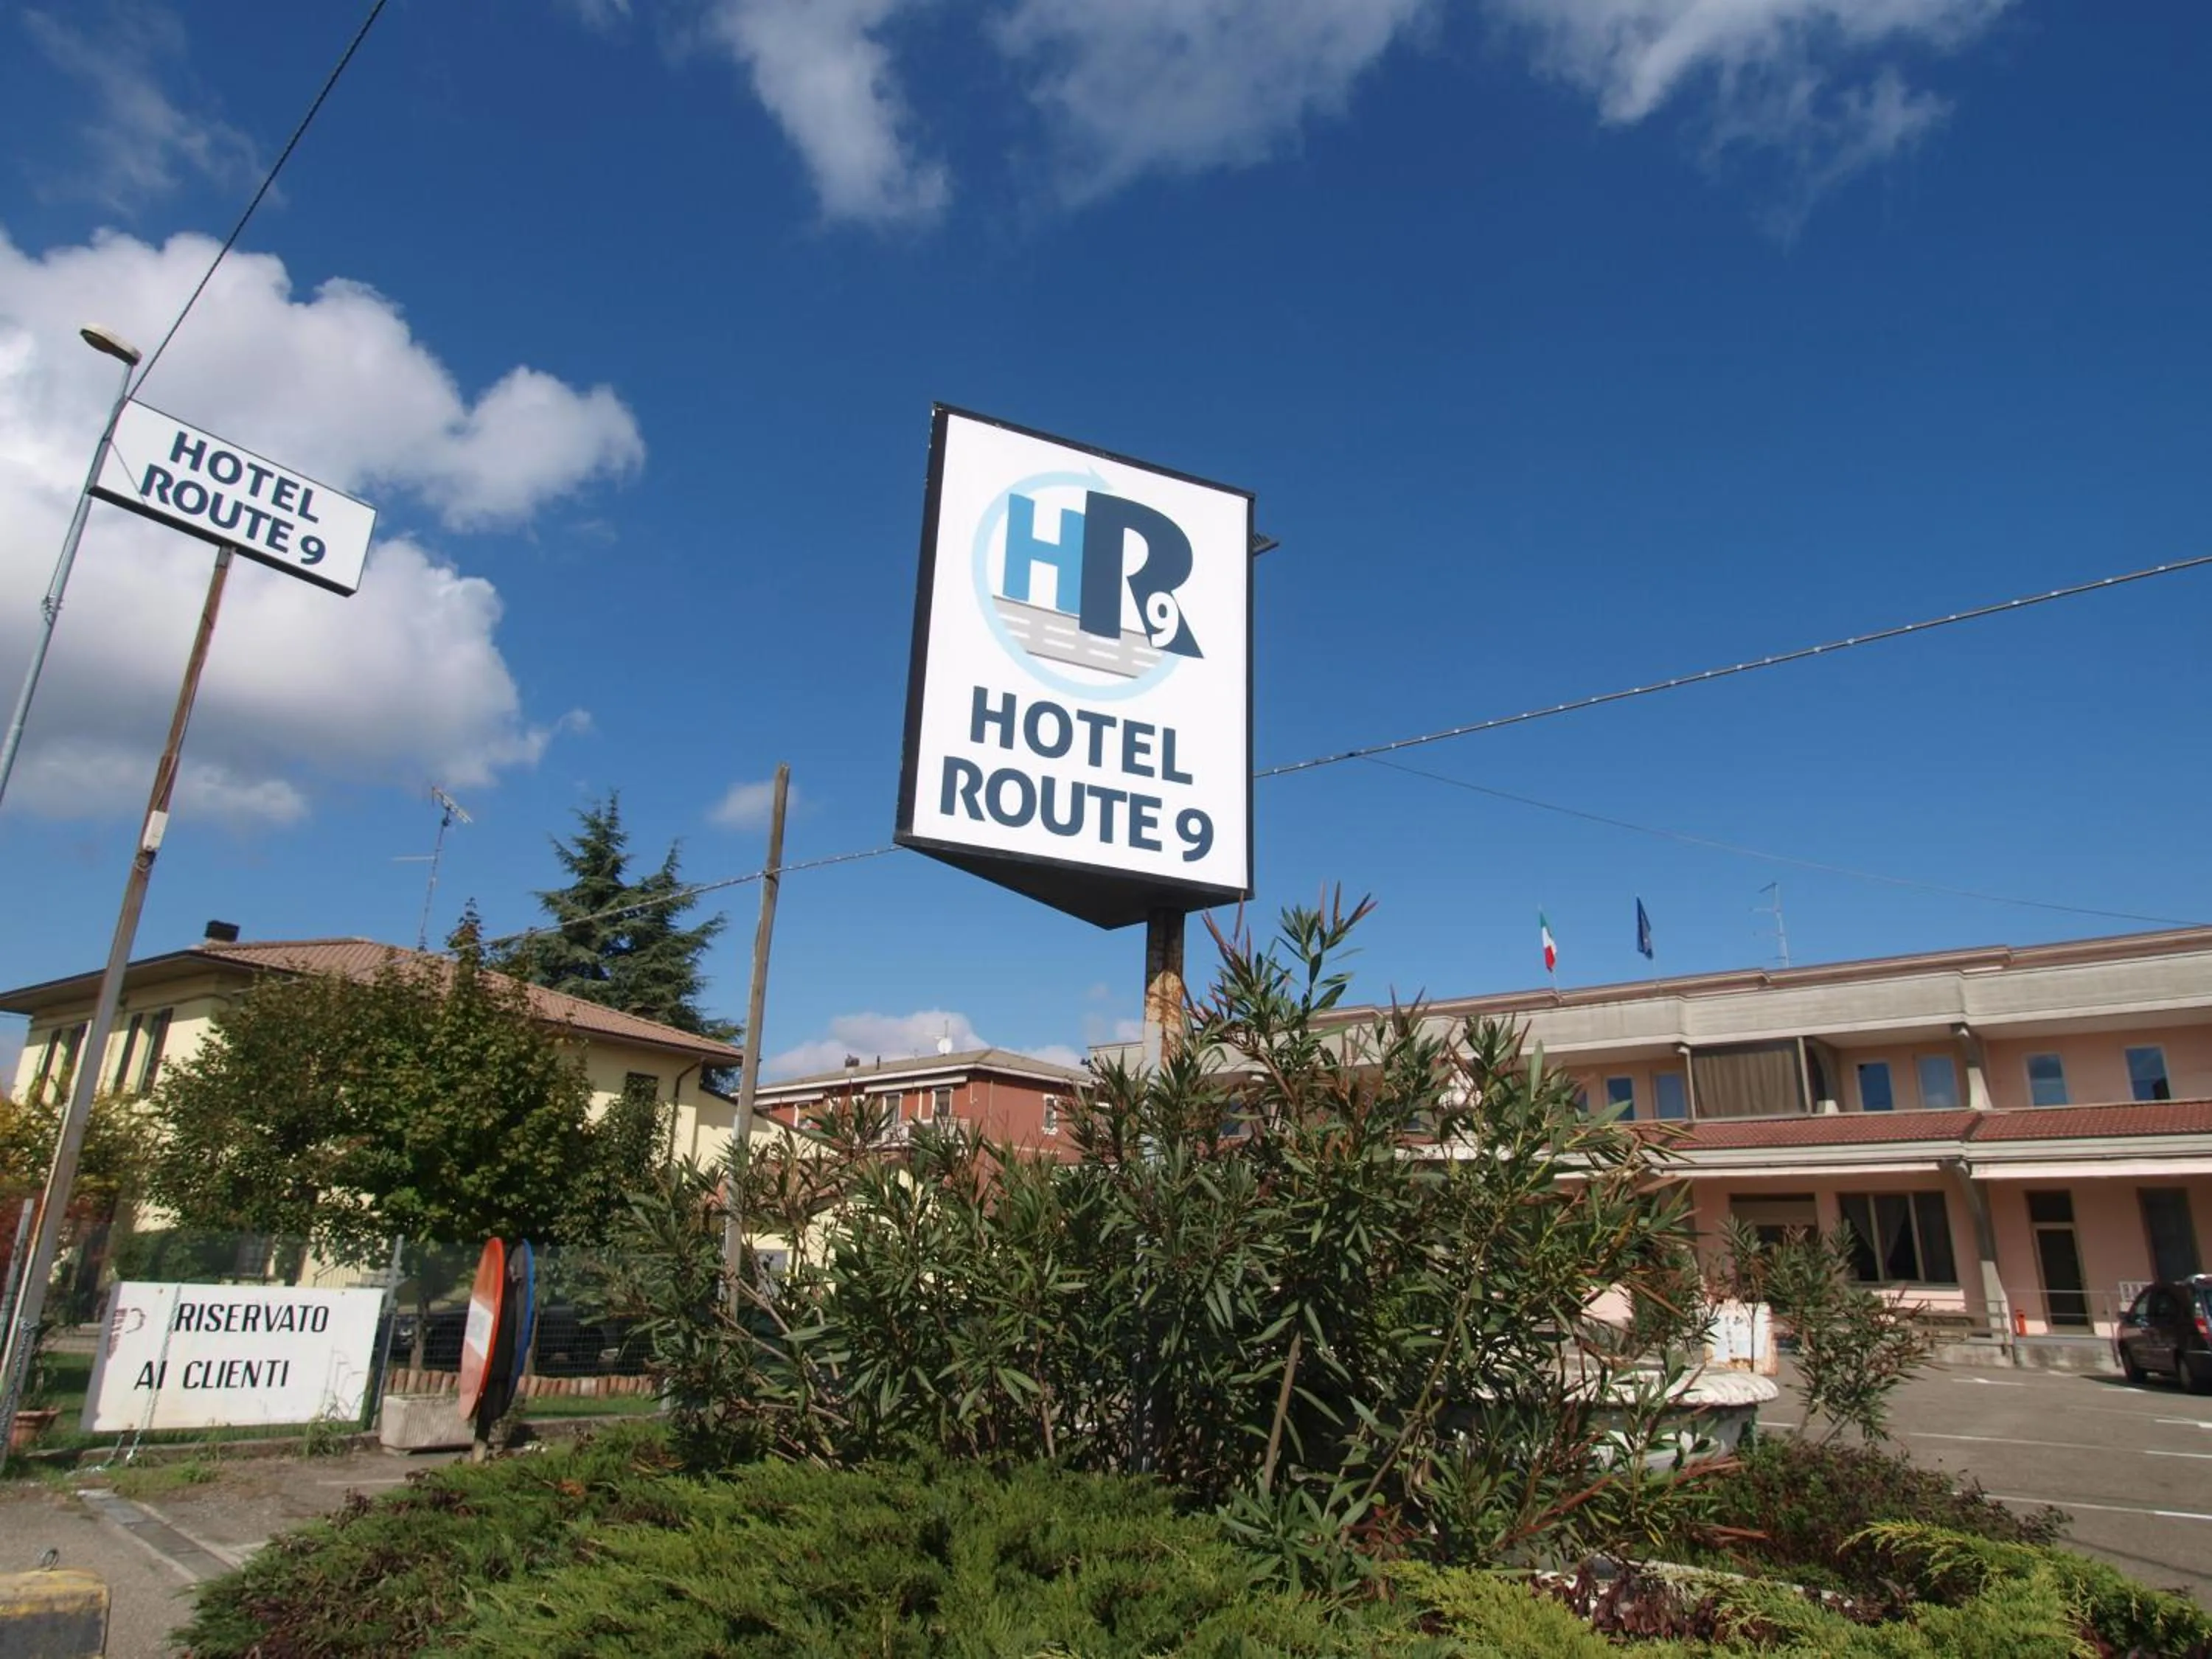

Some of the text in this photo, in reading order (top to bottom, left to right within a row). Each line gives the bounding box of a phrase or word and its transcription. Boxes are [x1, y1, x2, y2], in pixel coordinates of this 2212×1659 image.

[139, 464, 326, 566] ROUTE 9
[170, 431, 319, 524] HOTEL
[970, 685, 1193, 785] HOTEL
[939, 756, 1214, 862] ROUTE 9
[174, 1303, 329, 1332] RISERVATO
[133, 1360, 289, 1390] AI CLIENTI
